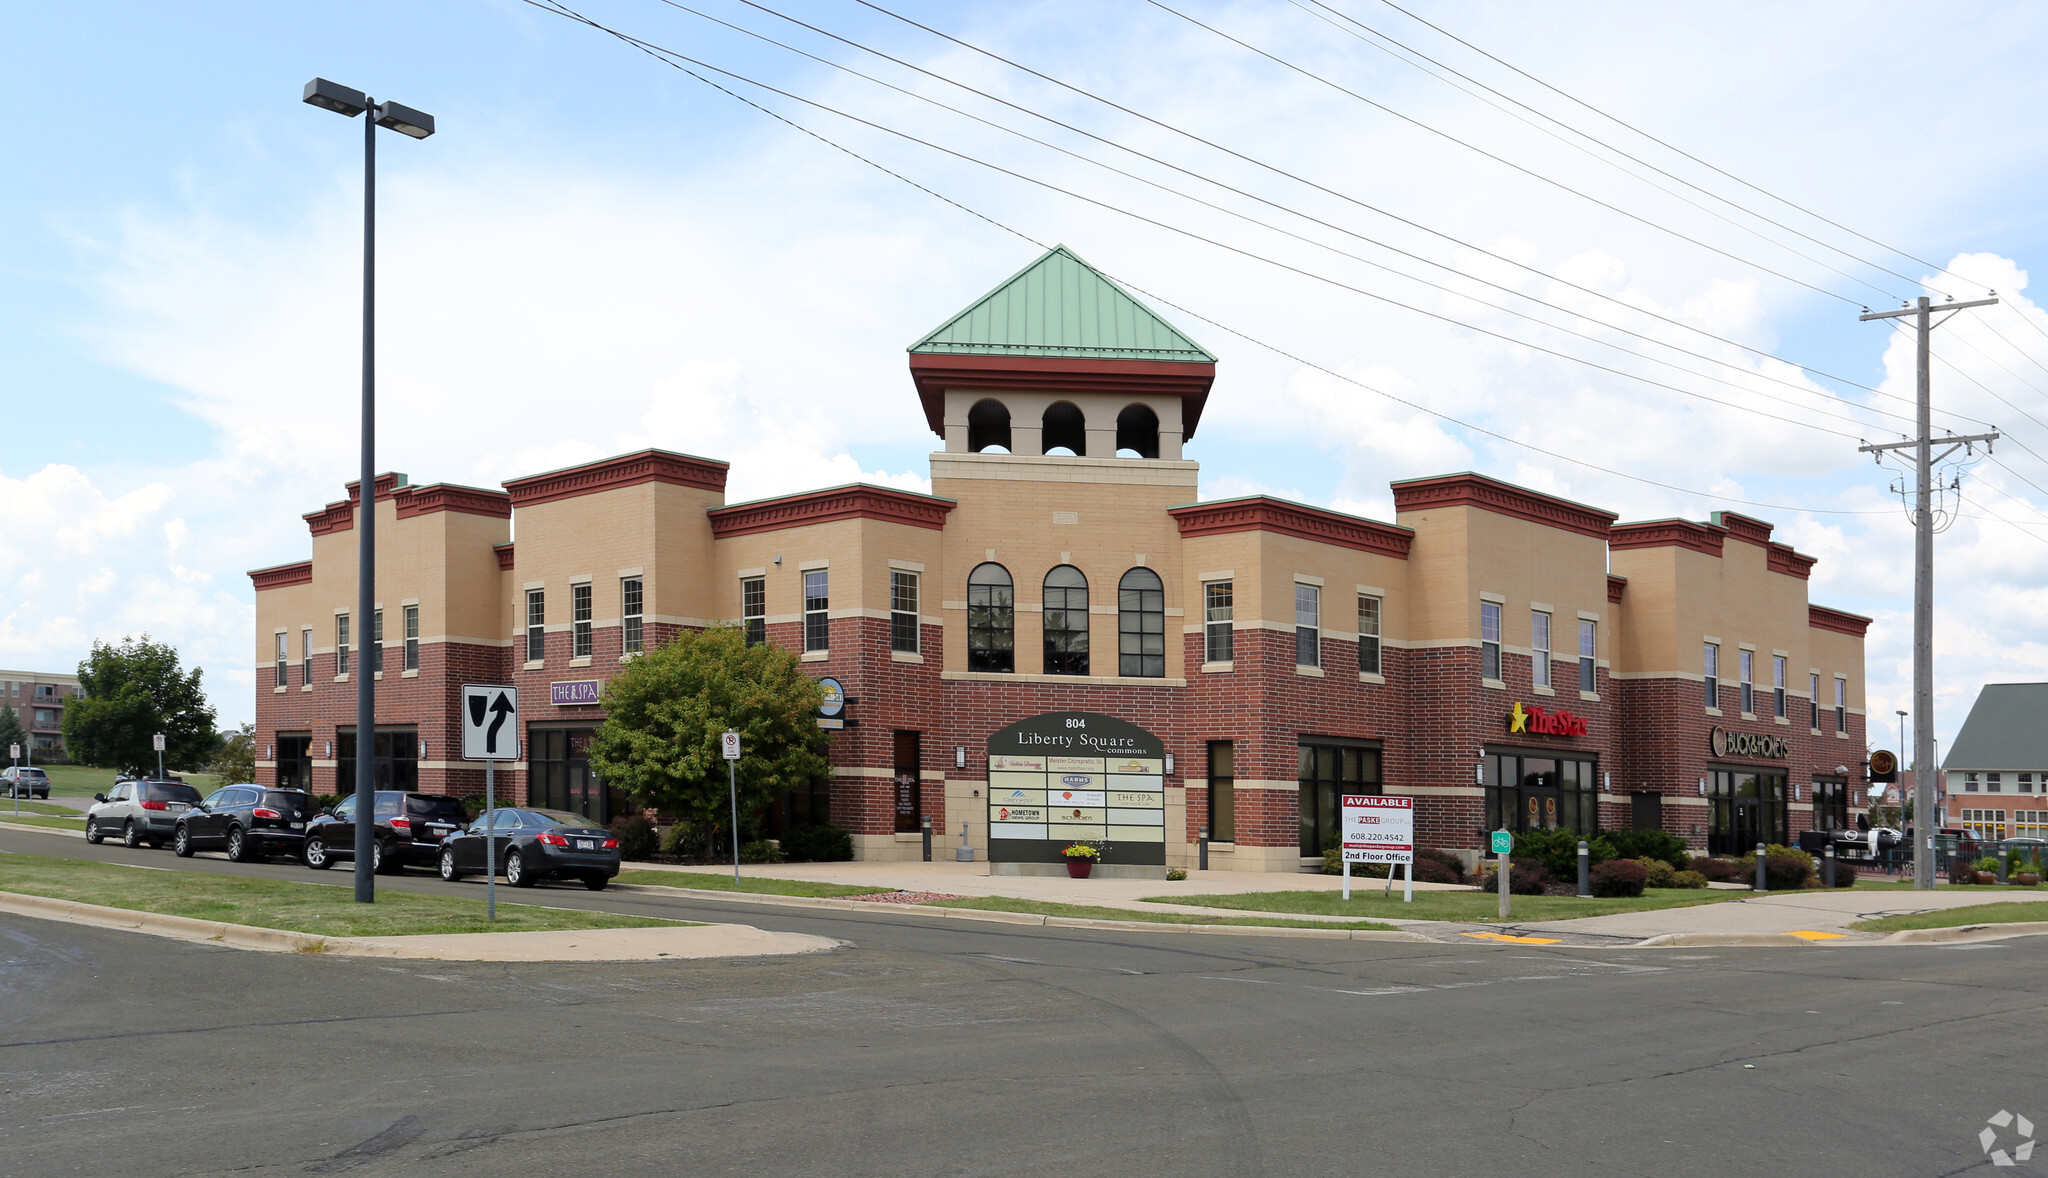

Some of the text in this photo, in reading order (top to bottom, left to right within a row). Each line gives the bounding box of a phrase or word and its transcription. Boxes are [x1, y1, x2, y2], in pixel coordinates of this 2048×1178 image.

[552, 683, 597, 700] THE SPA
[1065, 718, 1086, 729] 804
[1018, 732, 1134, 750] Liberty Square
[1107, 747, 1147, 755] commons
[1117, 793, 1154, 802] THE SPA
[1346, 797, 1409, 807] AVAILABLE
[1344, 816, 1357, 824] THE
[1358, 816, 1380, 824] PASKE
[1381, 817, 1404, 825] GROUP
[1350, 832, 1404, 842] 608.220.4542
[1345, 851, 1411, 862] 2nd Floor Office
